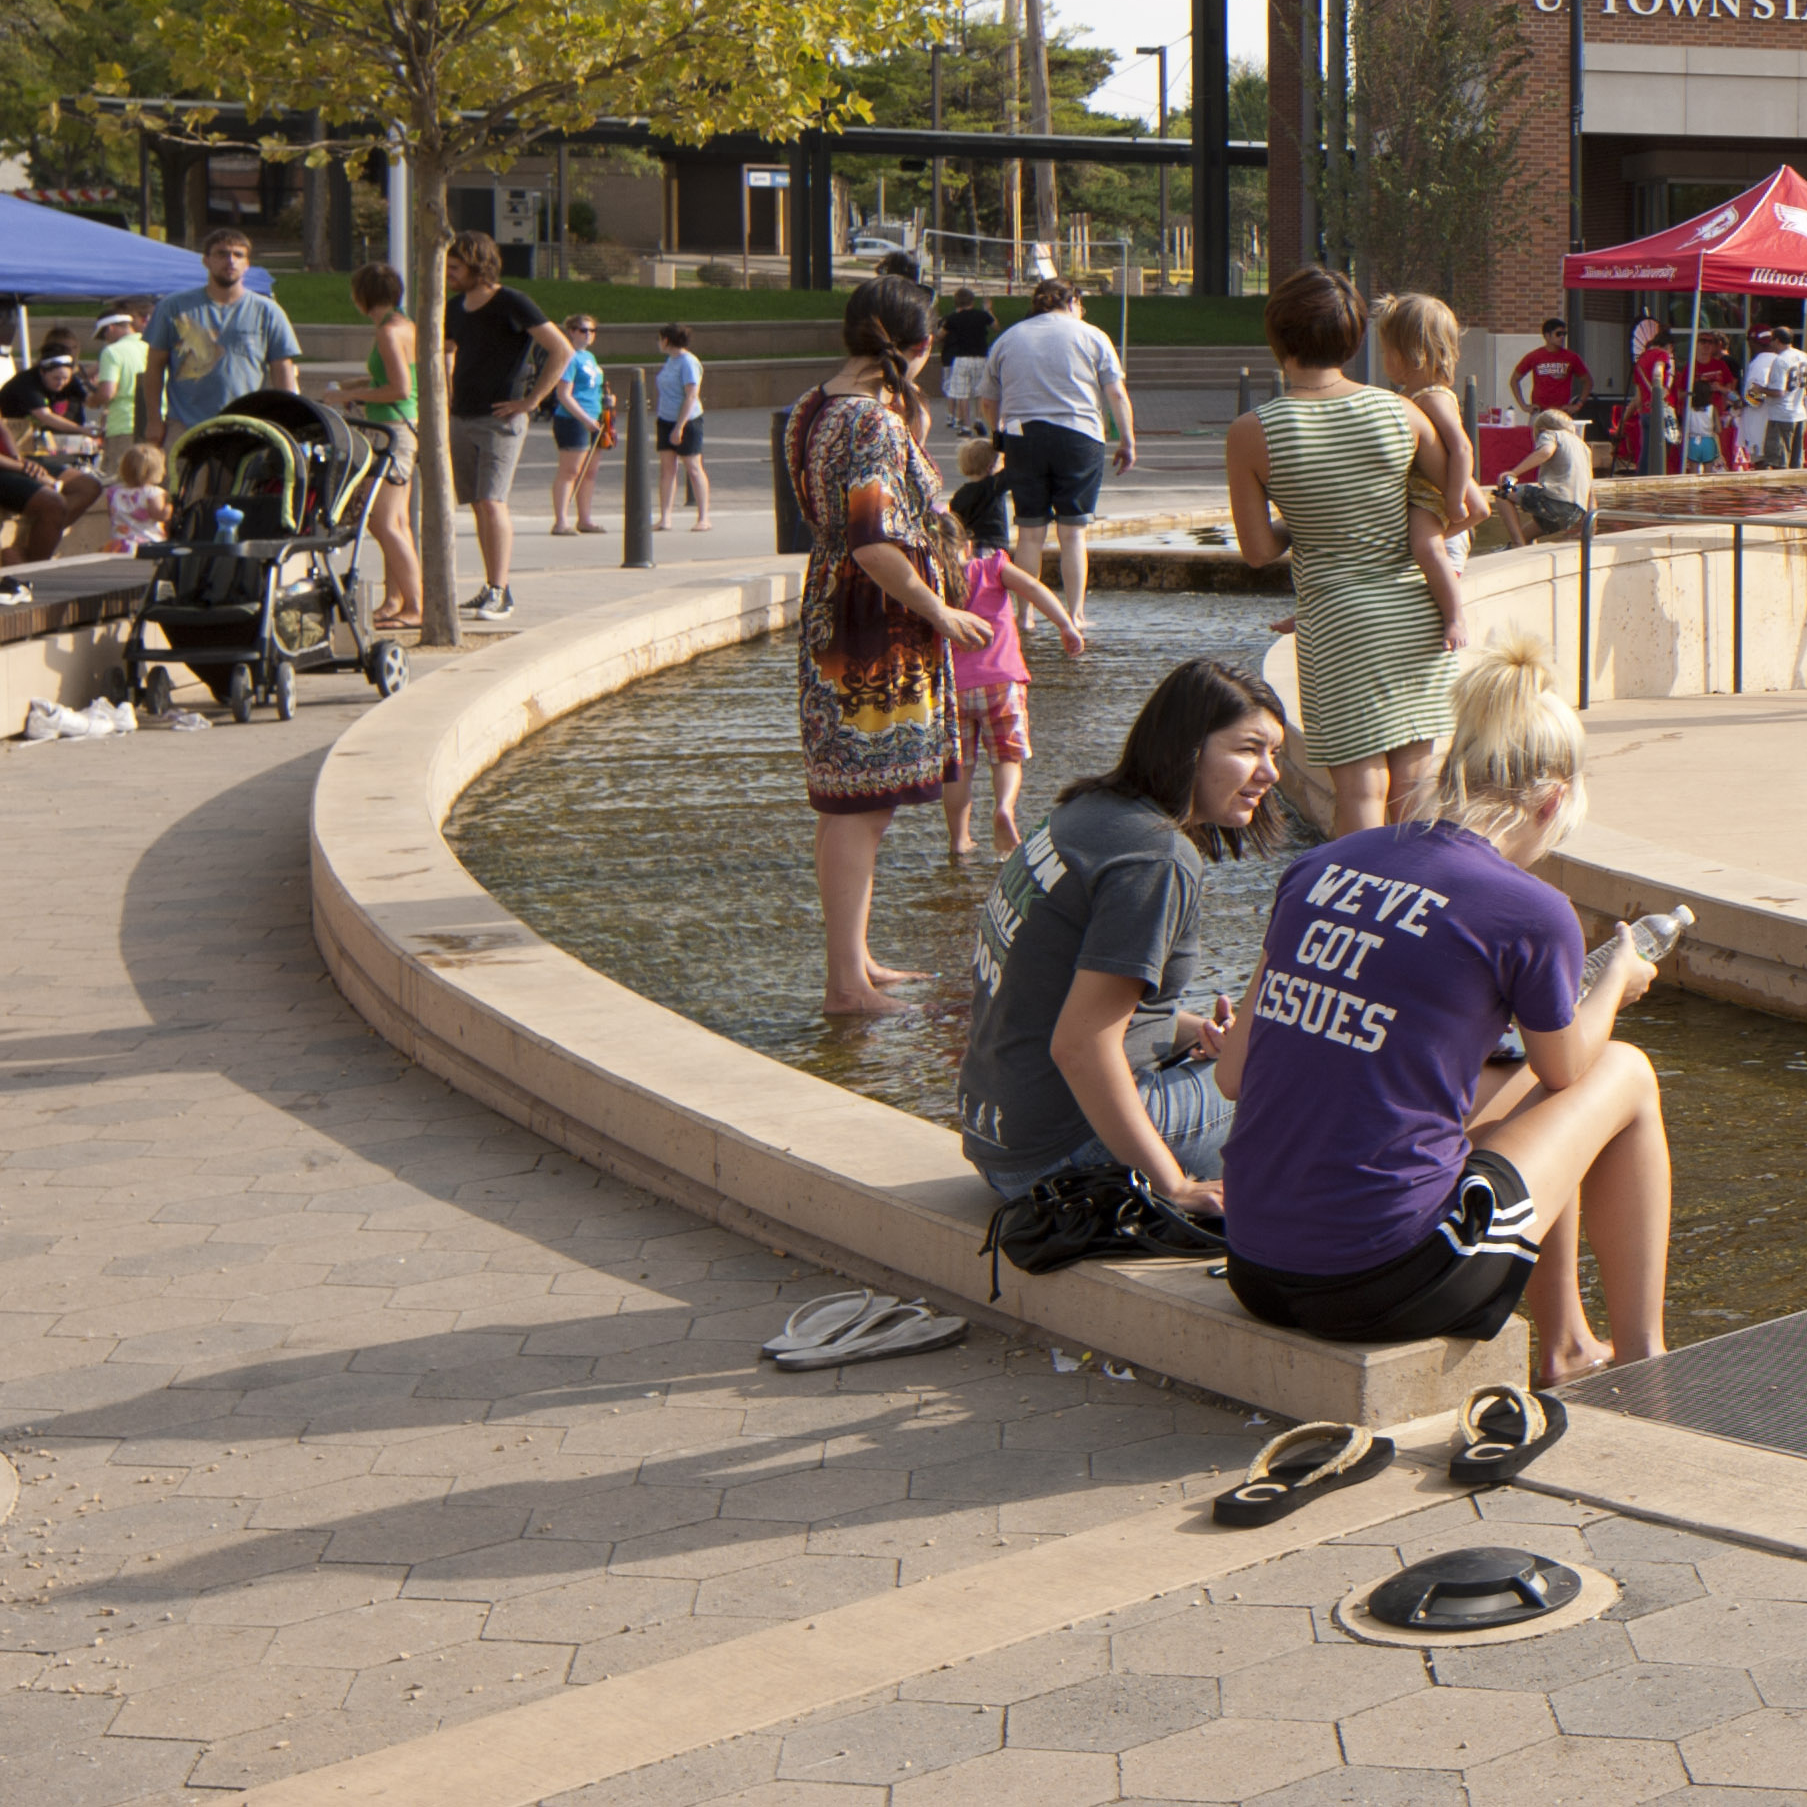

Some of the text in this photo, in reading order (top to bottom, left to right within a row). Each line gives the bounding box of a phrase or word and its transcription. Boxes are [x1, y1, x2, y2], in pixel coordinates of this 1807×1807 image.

[1305, 863, 1450, 937] WE'VE
[1296, 919, 1385, 981] GOT
[1255, 968, 1398, 1053] ISSUES
